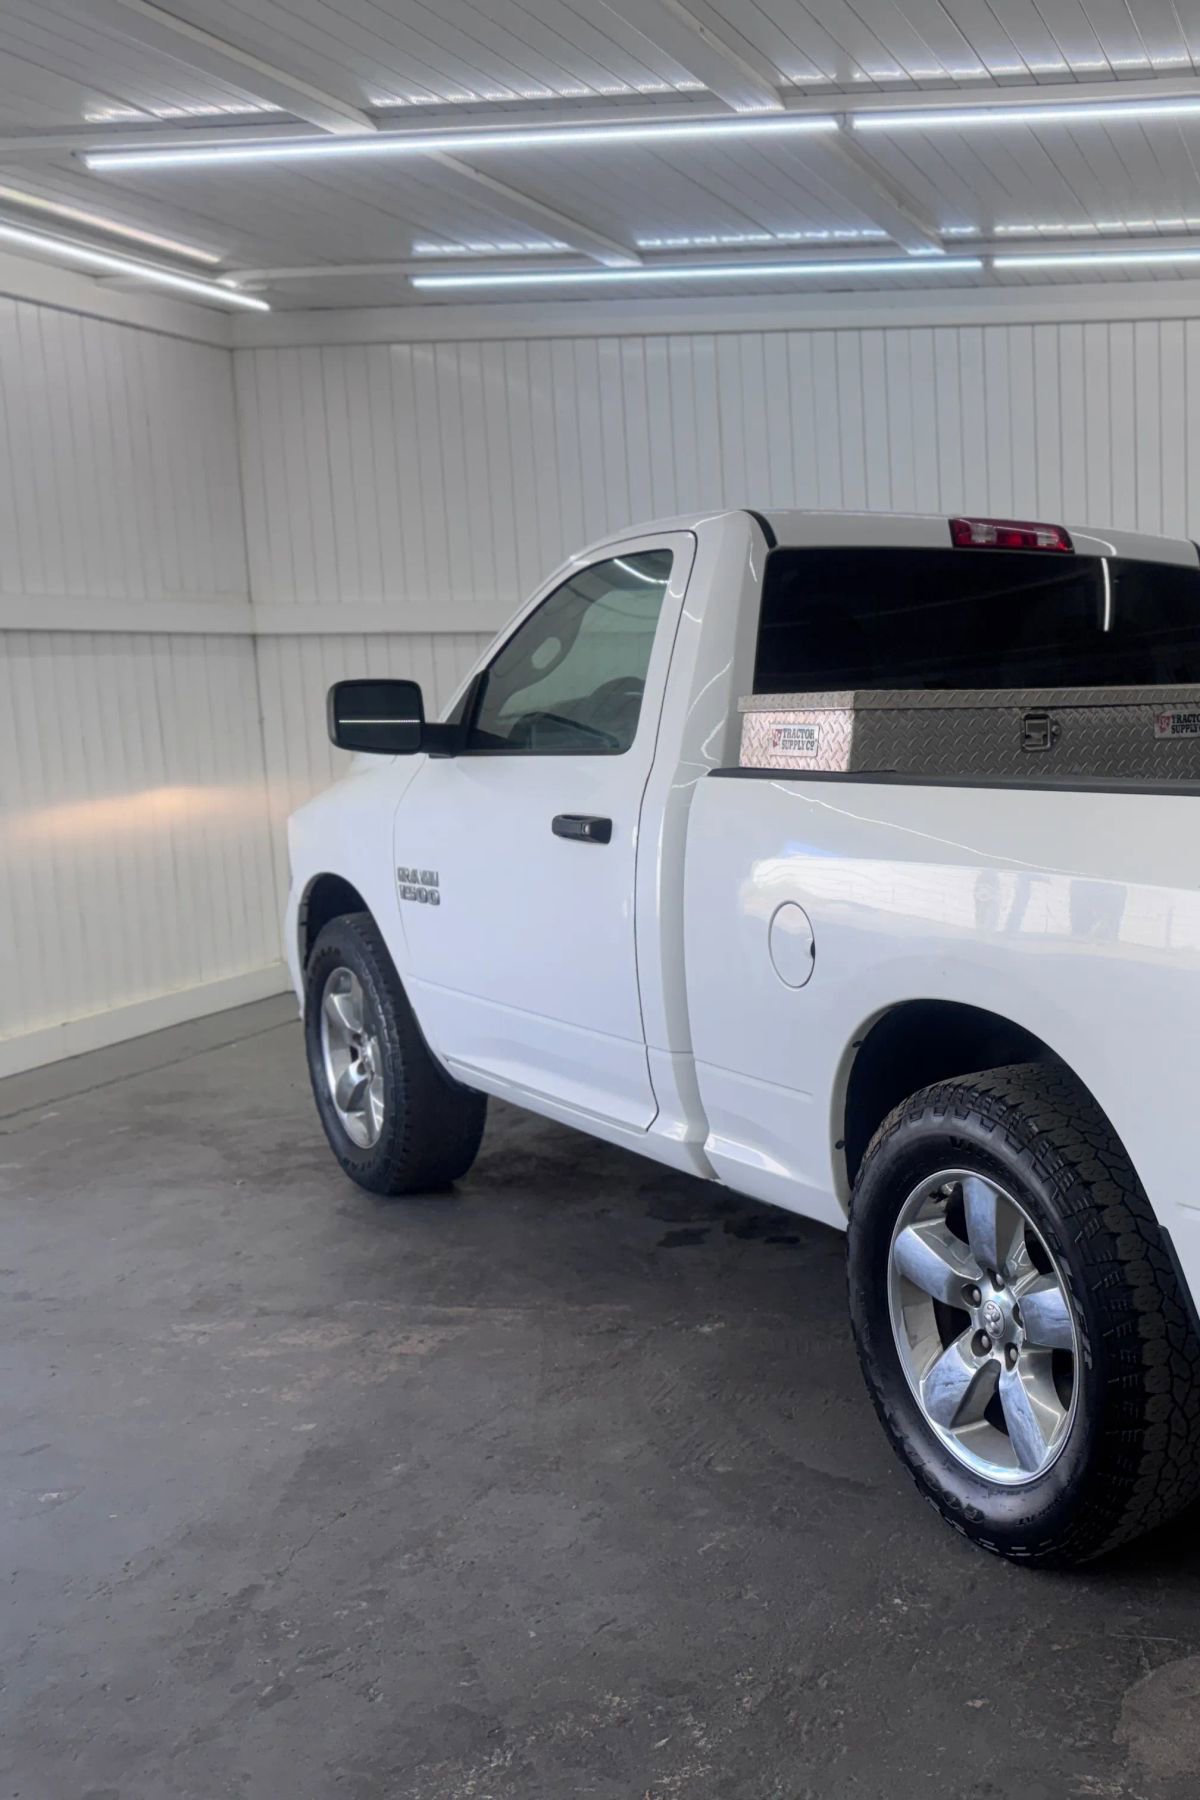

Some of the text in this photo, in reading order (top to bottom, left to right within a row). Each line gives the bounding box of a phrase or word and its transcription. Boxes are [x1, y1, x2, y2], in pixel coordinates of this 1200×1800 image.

[783, 728, 815, 739] TRACTOR
[1171, 724, 1197, 734] SUPPLY
[782, 740, 805, 750] SUPPLY
[397, 867, 439, 887] RAM
[400, 884, 441, 905] 1500
